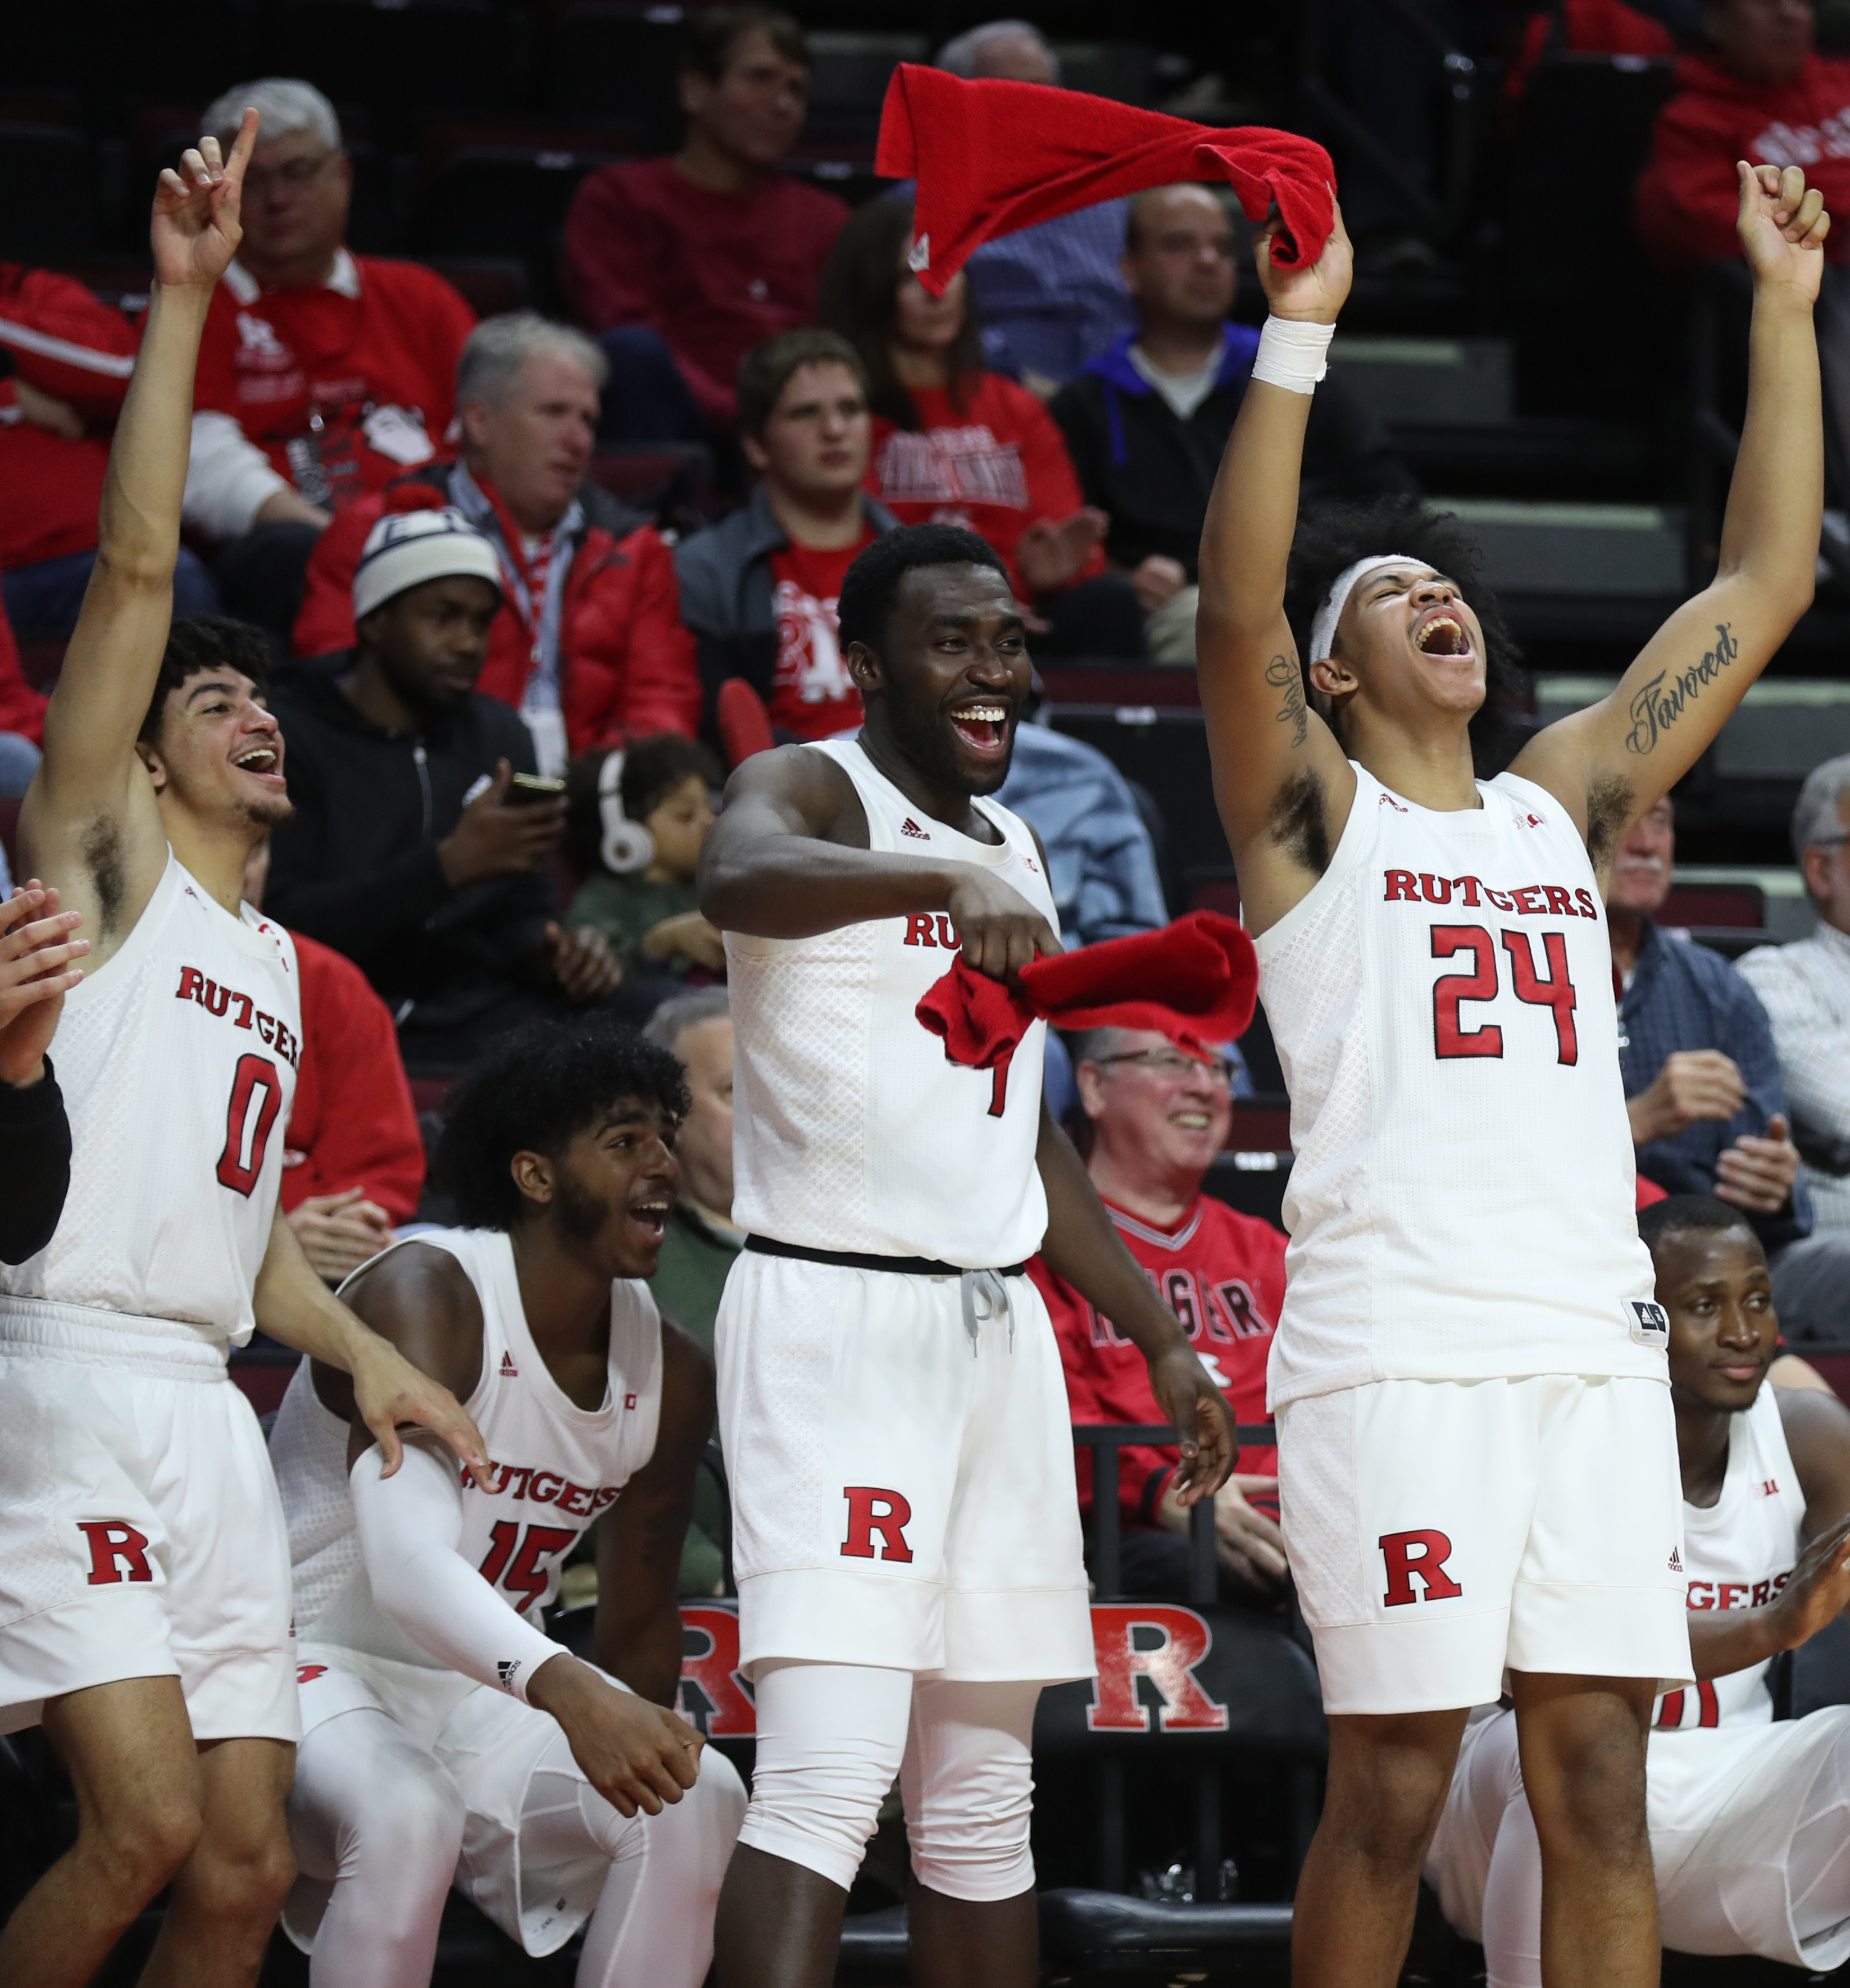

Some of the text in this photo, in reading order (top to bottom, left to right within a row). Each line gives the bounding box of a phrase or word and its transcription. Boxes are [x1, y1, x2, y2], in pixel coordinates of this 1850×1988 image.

[1626, 622, 1738, 754] Favored
[1384, 870, 1597, 920] RUTGERS
[1430, 924, 1578, 1066] 24
[216, 1053, 282, 1199] 0
[75, 1521, 152, 1585] R
[479, 1520, 579, 1614] 15
[840, 1486, 913, 1564] R
[1379, 1528, 1462, 1608] R
[672, 1605, 757, 1738] R
[1085, 1603, 1230, 1733] R
